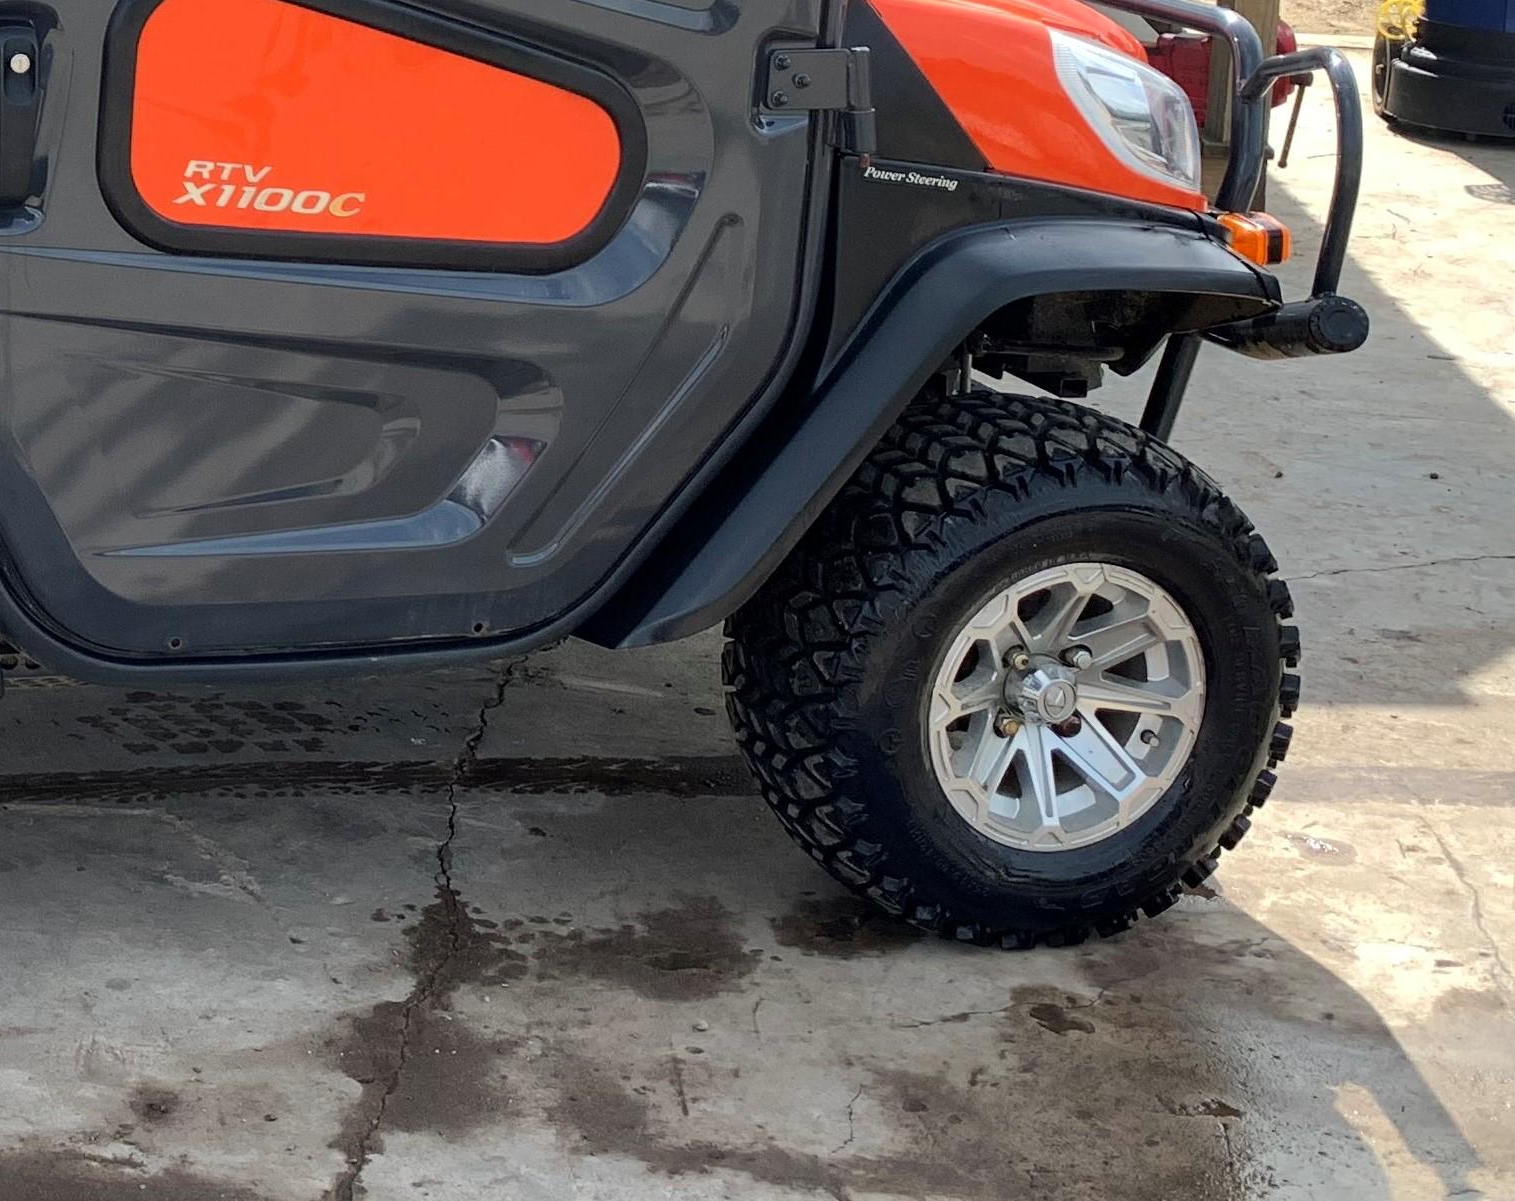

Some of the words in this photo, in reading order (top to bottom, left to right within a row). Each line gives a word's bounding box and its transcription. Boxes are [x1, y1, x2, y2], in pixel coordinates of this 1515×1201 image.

[184, 160, 273, 183] RTV
[864, 166, 906, 181] Power
[906, 172, 959, 191] Steering
[173, 181, 366, 217] X1100C
